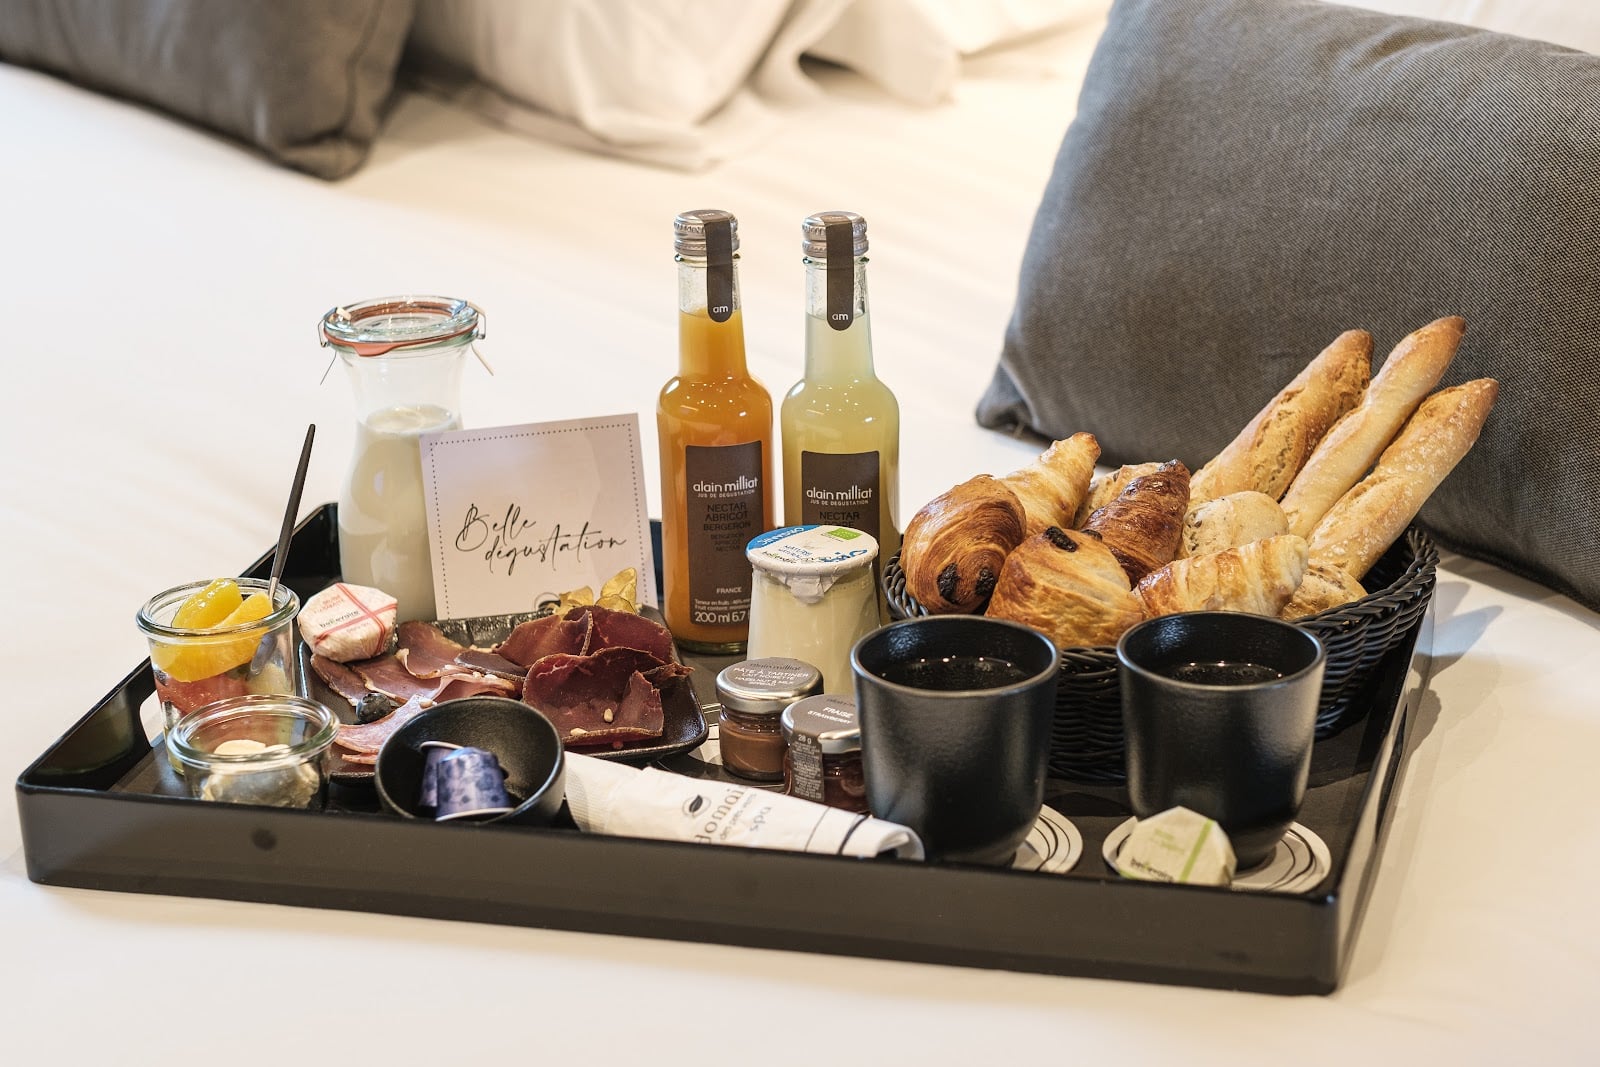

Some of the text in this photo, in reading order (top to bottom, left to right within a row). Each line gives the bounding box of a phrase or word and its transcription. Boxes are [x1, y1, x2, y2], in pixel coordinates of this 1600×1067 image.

[713, 305, 728, 314] am
[832, 313, 849, 321] am
[693, 475, 758, 492] alain milliat
[806, 484, 873, 500] alain milliat
[707, 502, 747, 512] NECTAR
[705, 511, 749, 522] ABRICOT
[820, 511, 860, 520] NECTAR
[455, 503, 536, 551] Belle
[695, 611, 717, 623] 200
[822, 706, 854, 719] FRAISE
